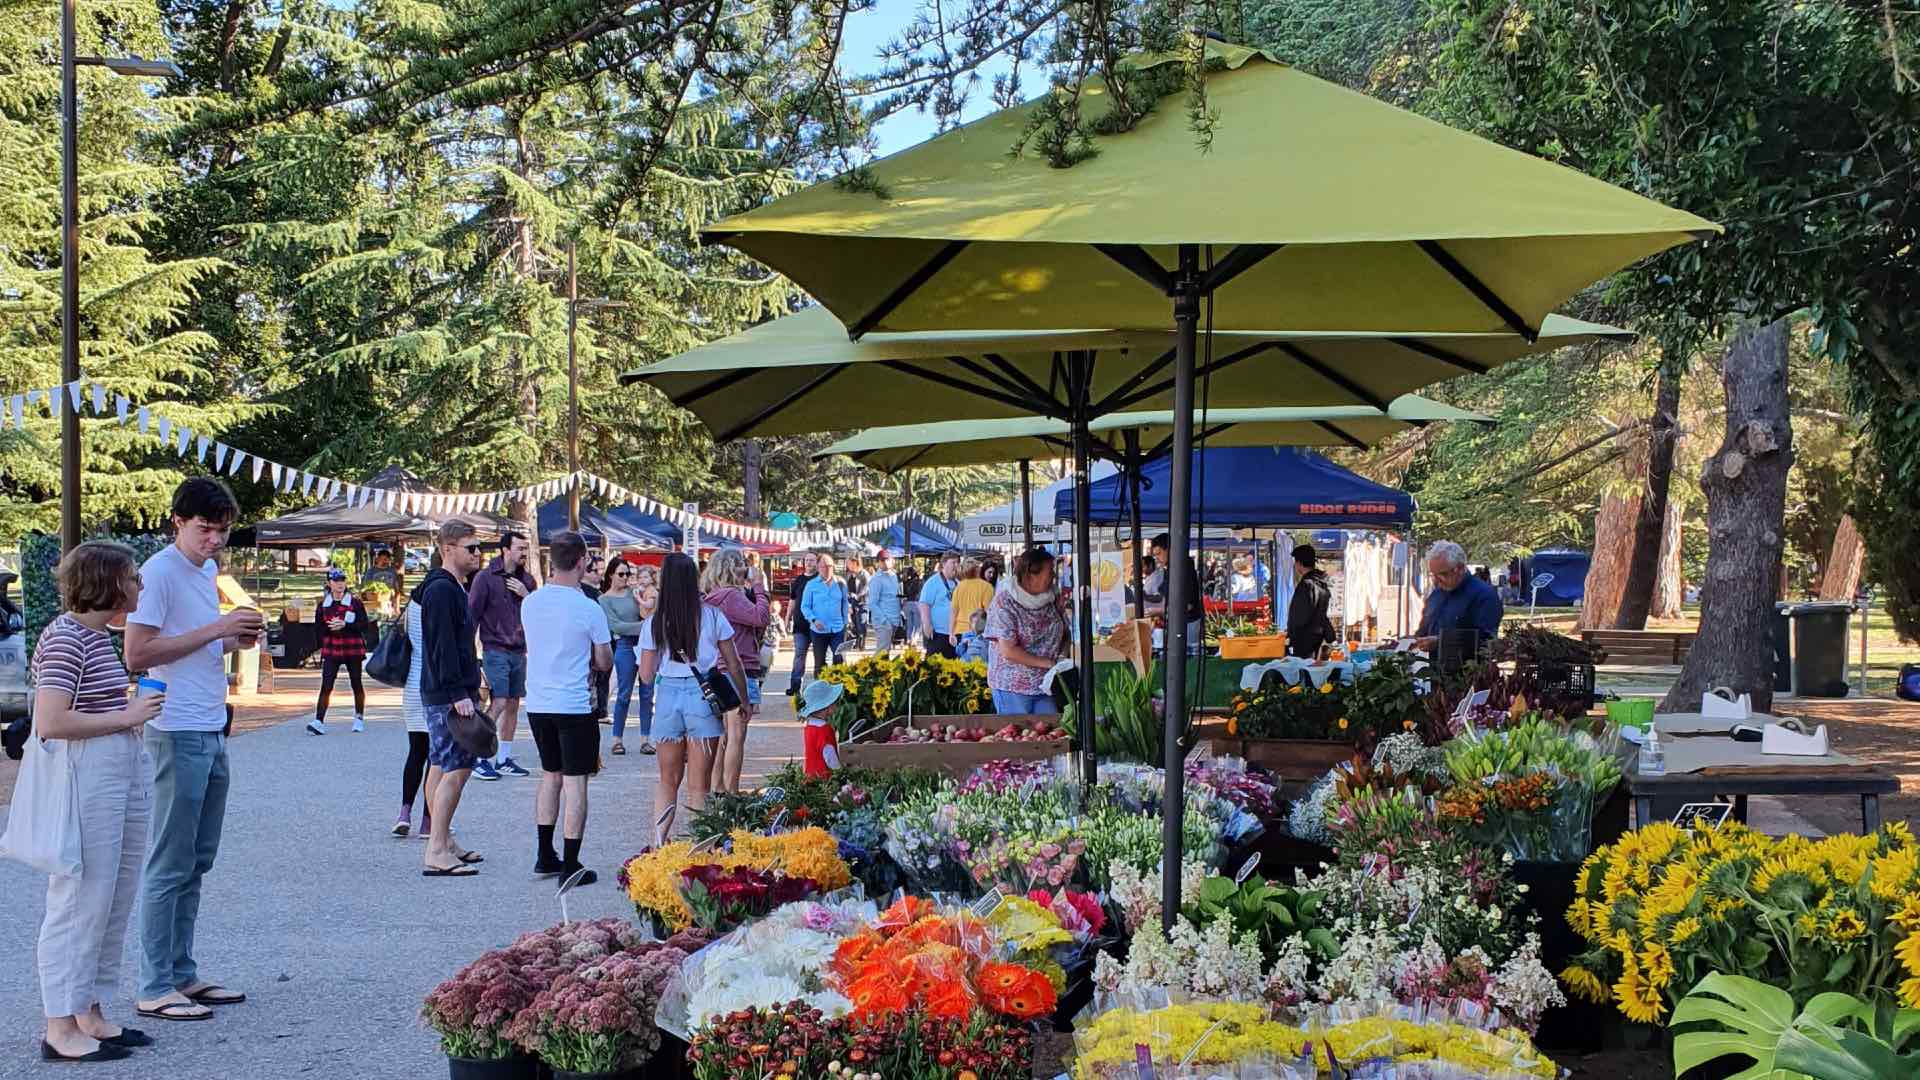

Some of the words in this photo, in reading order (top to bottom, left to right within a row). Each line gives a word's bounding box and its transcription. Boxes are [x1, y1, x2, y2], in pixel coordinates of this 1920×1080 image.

[1300, 504, 1344, 513] RIDGE
[1347, 504, 1397, 513] RYDER
[981, 525, 1004, 535] ARB
[1008, 524, 1057, 535] TORING
